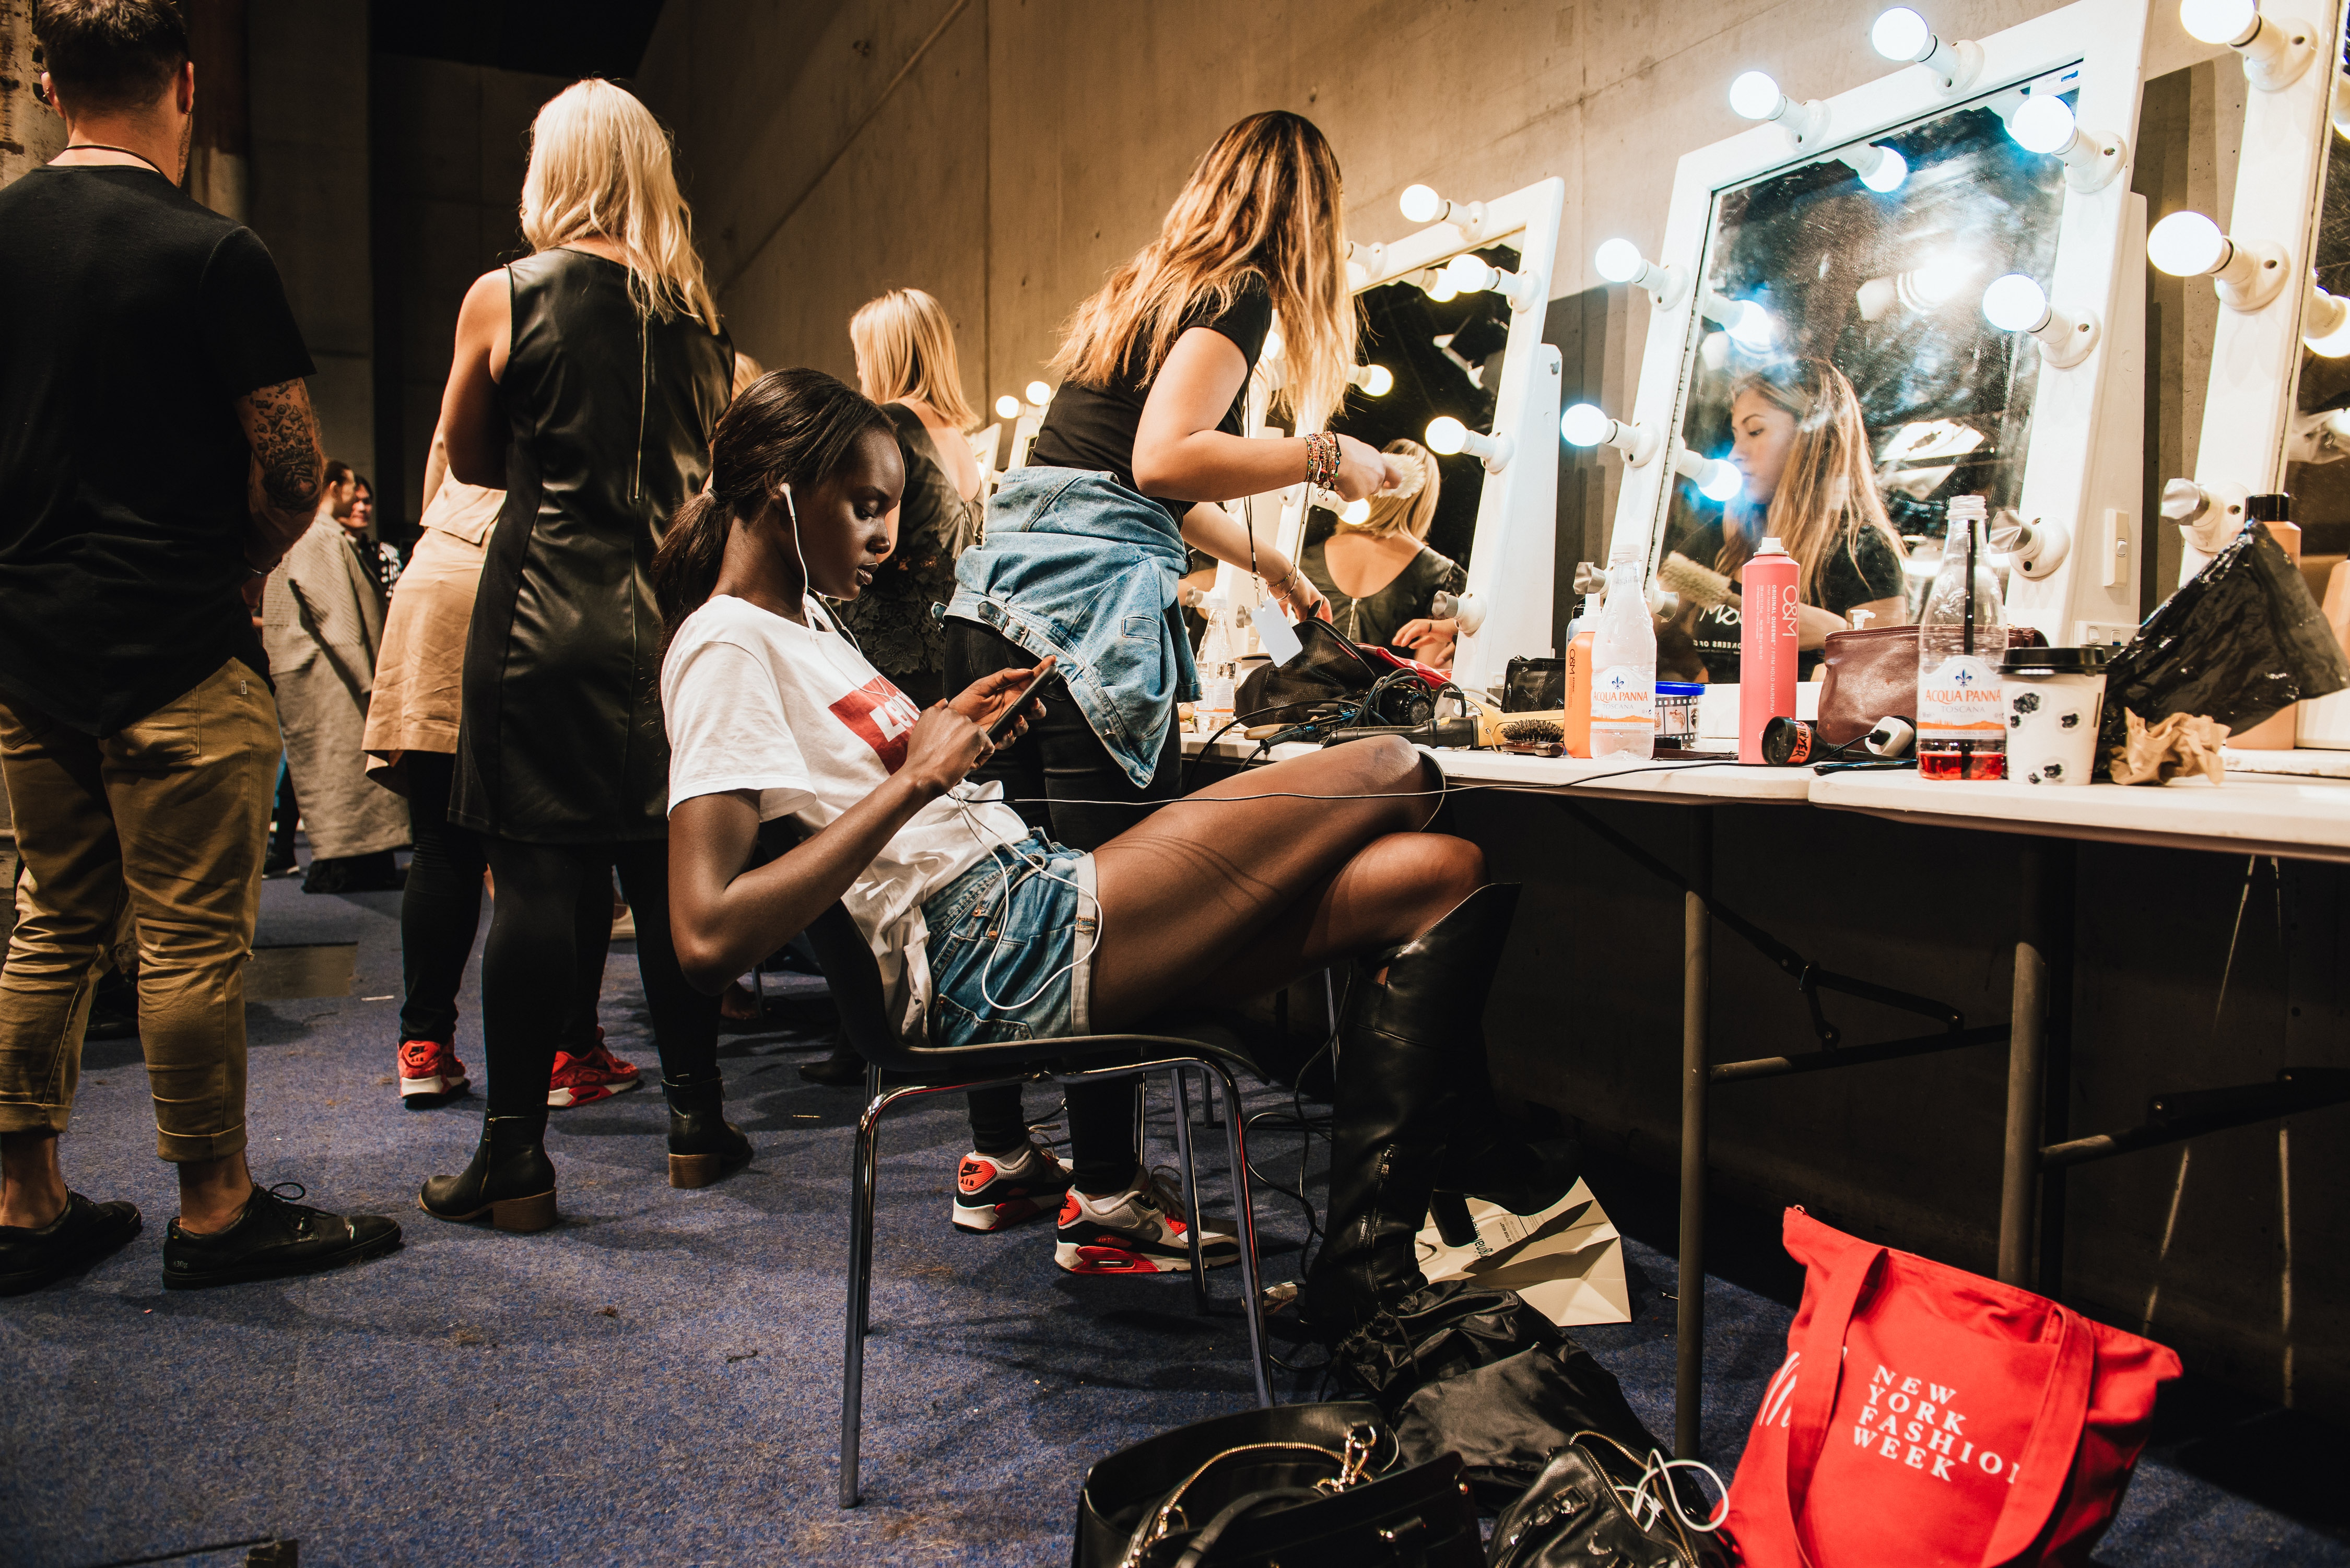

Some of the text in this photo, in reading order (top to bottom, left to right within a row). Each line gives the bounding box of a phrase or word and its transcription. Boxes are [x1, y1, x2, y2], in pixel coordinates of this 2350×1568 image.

[1782, 585, 1797, 636] O&M
[1593, 691, 1648, 703] ACQUA PANNA
[1924, 689, 2002, 705] ACQUA PANNA
[960, 1178, 974, 1186] AIR
[1872, 1364, 1956, 1405] NEW
[1868, 1384, 1966, 1435] YORK
[1854, 1425, 1955, 1482] WEEK
